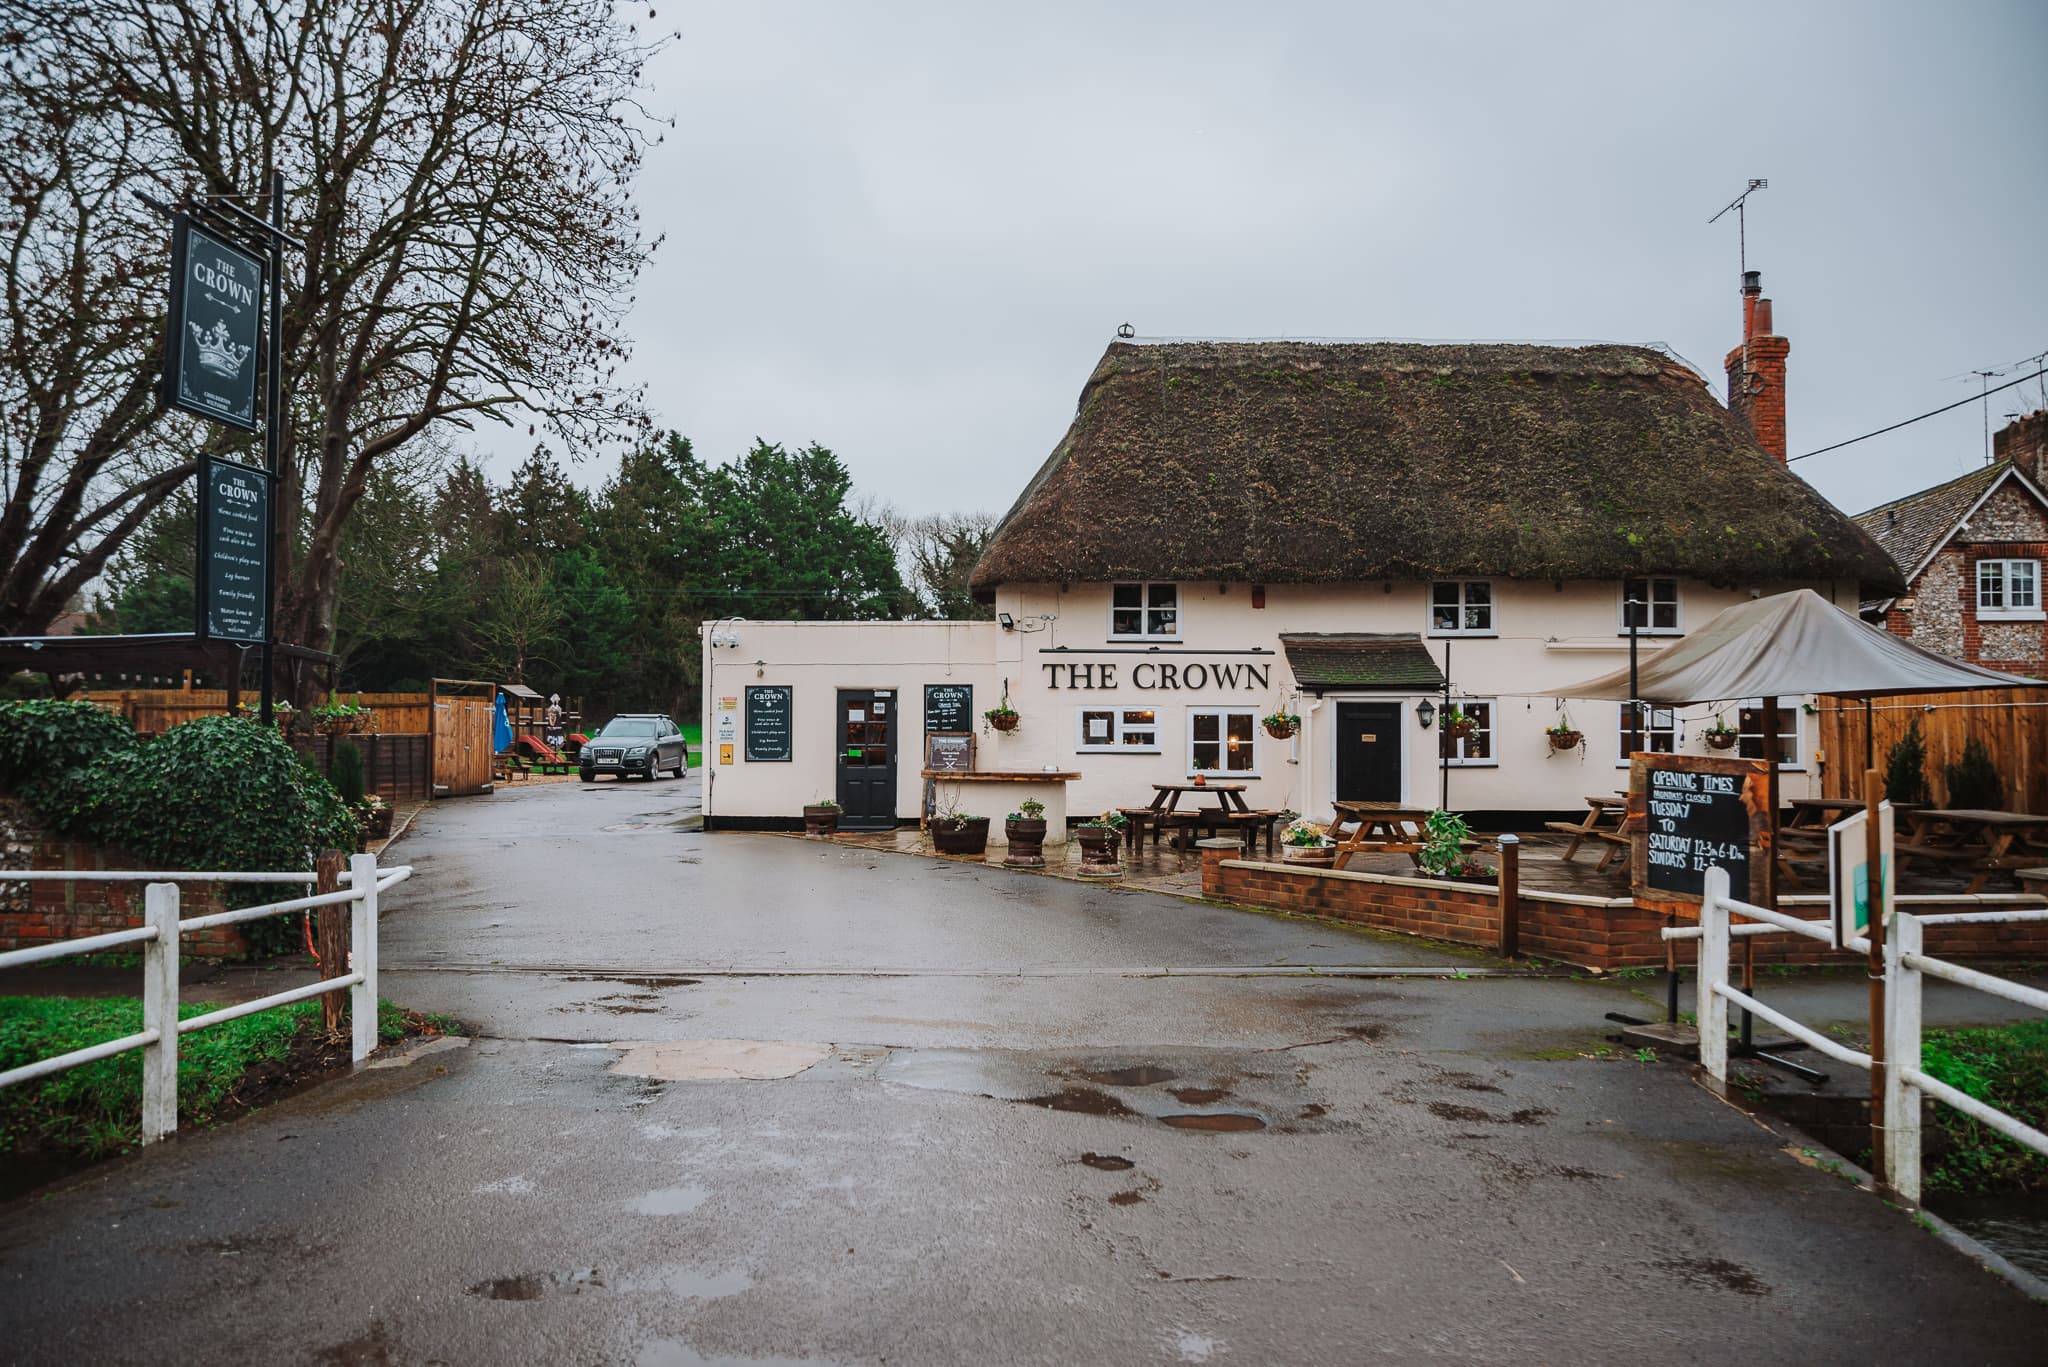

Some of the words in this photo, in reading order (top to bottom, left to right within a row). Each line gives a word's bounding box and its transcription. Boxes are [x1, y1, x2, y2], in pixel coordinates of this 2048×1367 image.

[216, 258, 235, 277] THE
[194, 263, 253, 306] CROWN
[232, 478, 246, 487] THE
[219, 483, 257, 503] CROWN
[218, 507, 231, 515] Home
[247, 514, 258, 522] food
[214, 552, 238, 562] Children's
[239, 556, 249, 565] play
[225, 572, 233, 581] Log
[234, 573, 250, 581] burner
[219, 589, 236, 599] Family
[236, 591, 255, 601] friendly
[1042, 663, 1118, 689] THE
[1132, 663, 1272, 690] CROWN
[1653, 771, 1697, 789] OPENING
[1700, 775, 1734, 791] TIMES
[1685, 793, 1712, 804] CLOSED
[1648, 801, 1690, 818] TUESDAY
[1658, 818, 1675, 832] TO
[1649, 833, 1691, 853] SATURDAY
[1649, 850, 1686, 868] SUNDAYS
